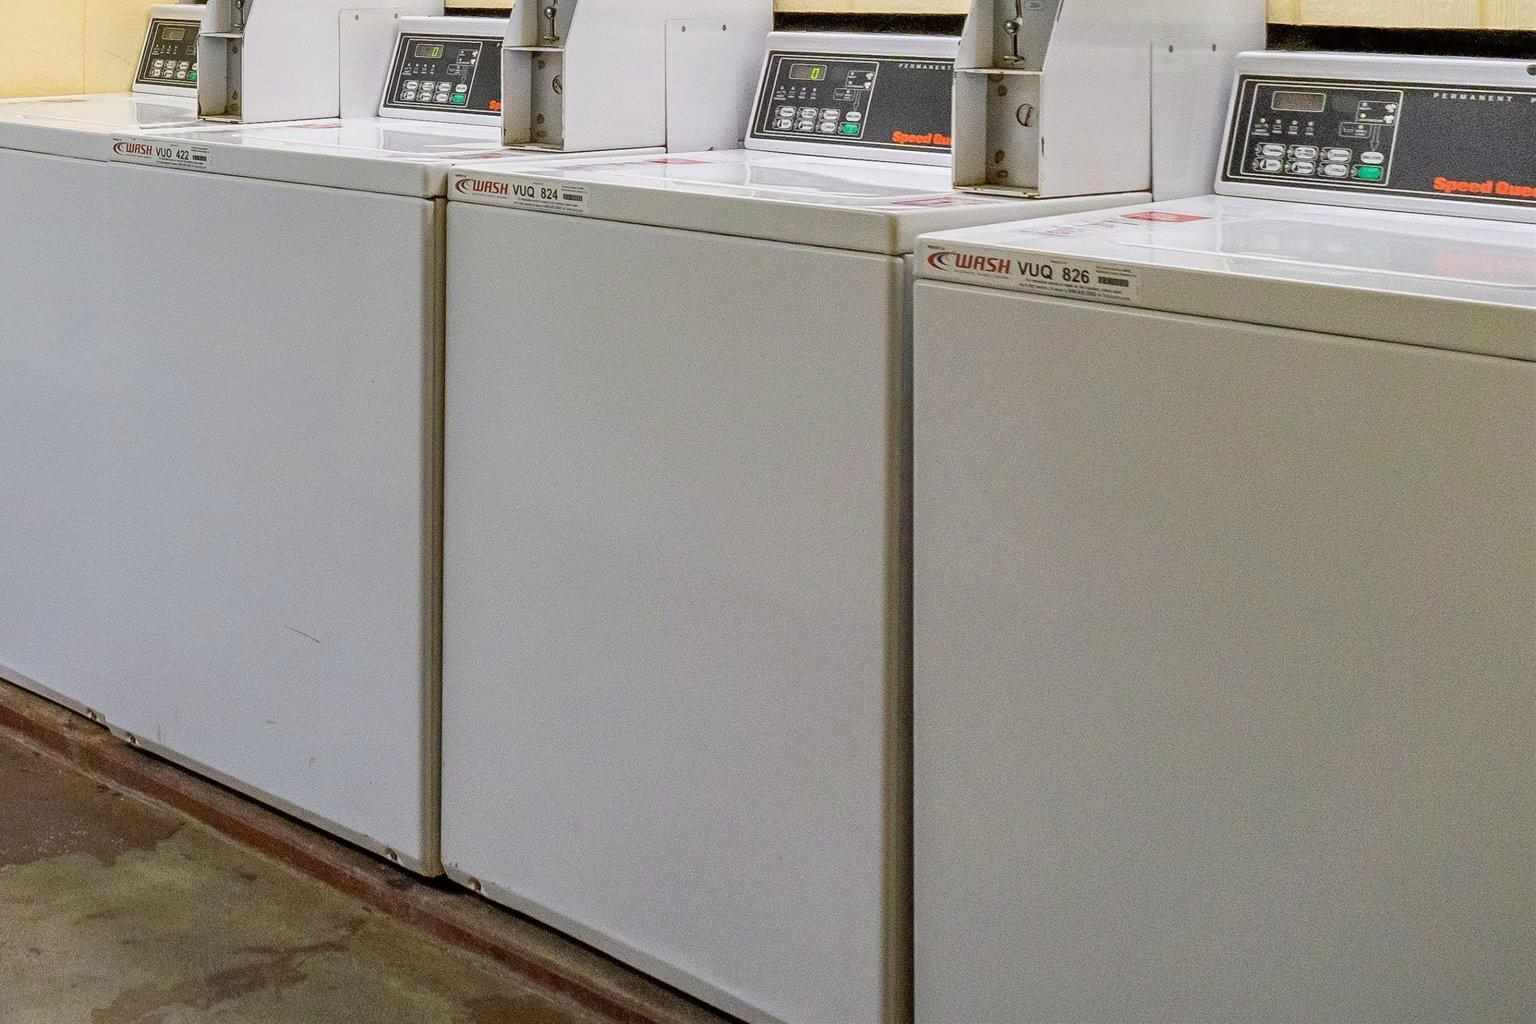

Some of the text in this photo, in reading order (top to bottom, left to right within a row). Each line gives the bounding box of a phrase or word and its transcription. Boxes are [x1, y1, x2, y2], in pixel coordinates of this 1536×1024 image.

[1433, 92, 1513, 102] PERMANENT
[126, 142, 153, 156] WASH
[175, 148, 190, 161] 422
[472, 179, 509, 195] WASH
[512, 183, 535, 198] VUQ
[540, 187, 559, 201] 824
[1432, 176, 1493, 193] Speed
[954, 253, 1012, 275] WASH
[1017, 260, 1054, 280] VUQ
[1062, 266, 1091, 284] 826
